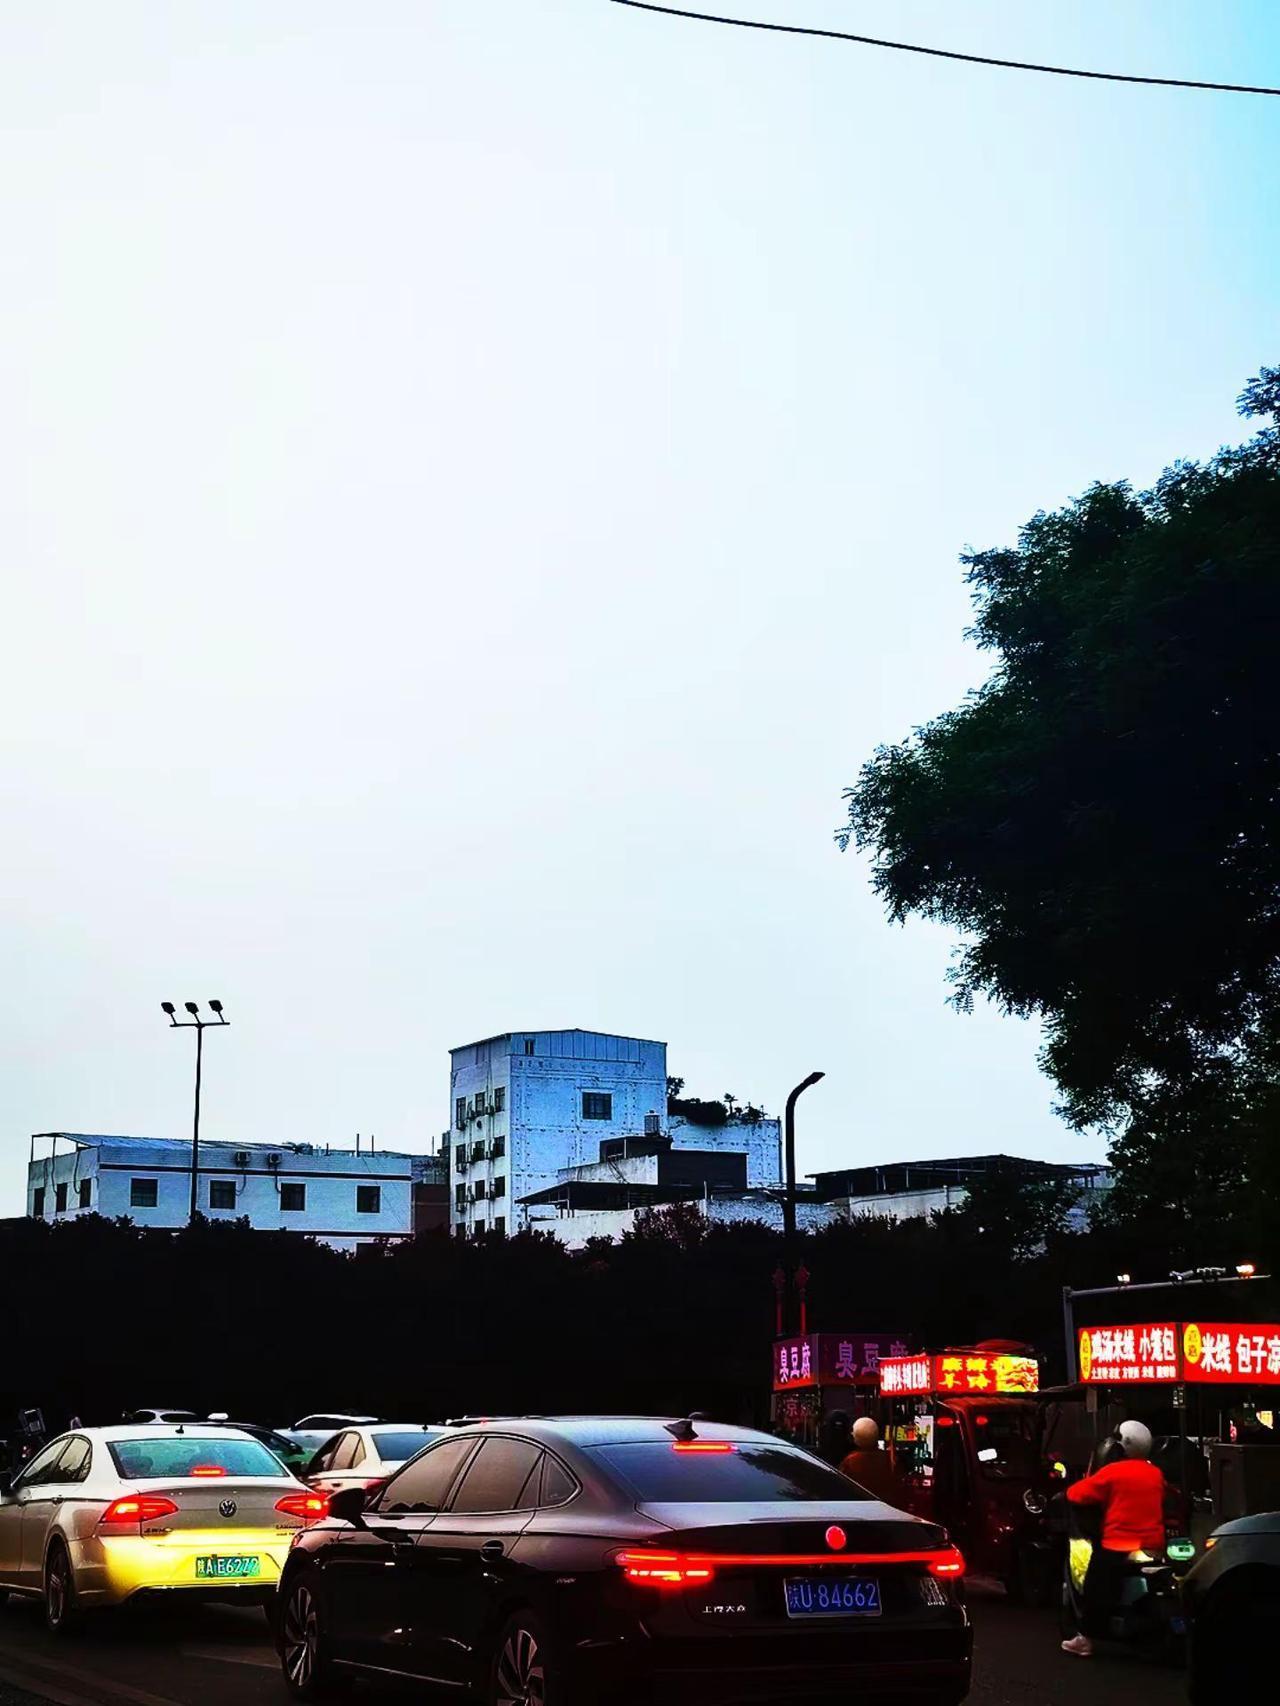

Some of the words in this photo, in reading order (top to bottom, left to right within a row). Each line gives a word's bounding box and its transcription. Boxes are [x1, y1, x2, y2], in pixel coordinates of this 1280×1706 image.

[780, 1343, 811, 1383] 臭豆腐
[1201, 1333, 1232, 1374] 米线
[789, 1583, 878, 1609] 陕U·84662
